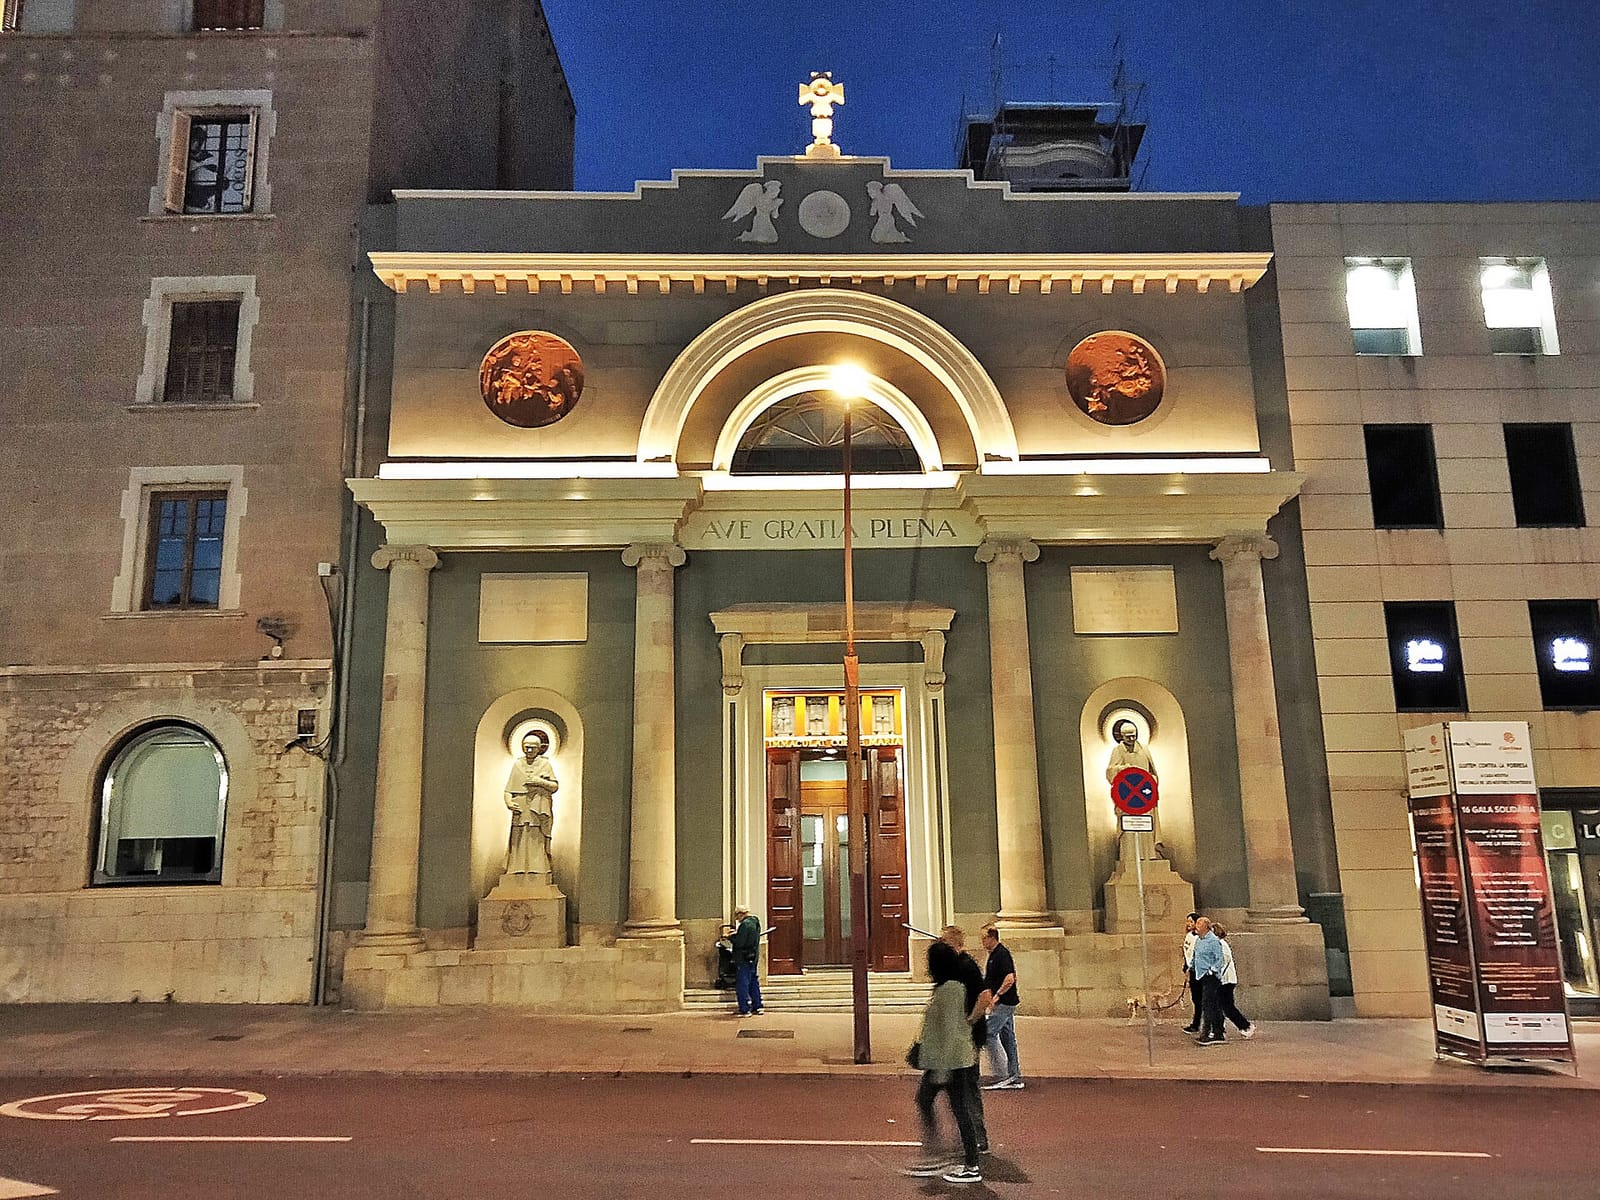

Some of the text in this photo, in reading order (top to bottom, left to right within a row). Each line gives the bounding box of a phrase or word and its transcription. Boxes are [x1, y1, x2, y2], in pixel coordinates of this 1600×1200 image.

[701, 518, 957, 540] AVE GRATIA PLENA
[1471, 806, 1494, 814] GALA
